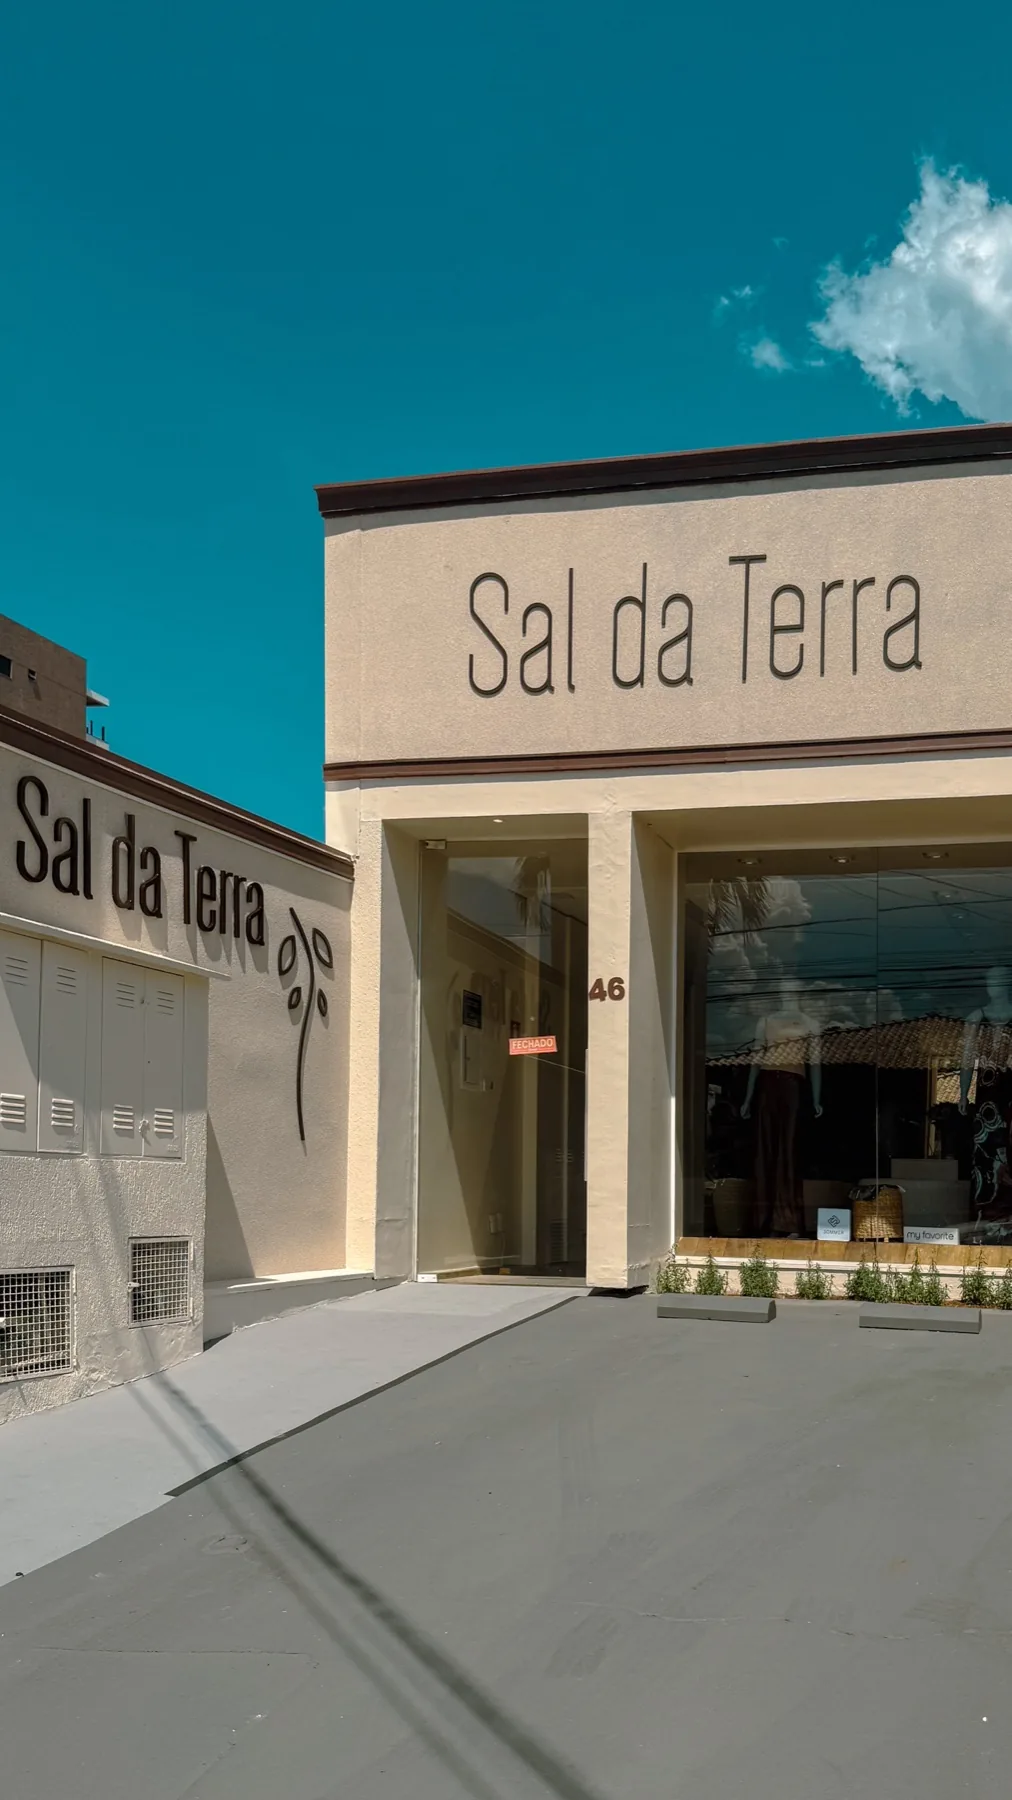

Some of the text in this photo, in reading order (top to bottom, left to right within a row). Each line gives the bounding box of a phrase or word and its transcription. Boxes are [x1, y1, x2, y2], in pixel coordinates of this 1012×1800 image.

[469, 554, 923, 697] Sal da Terra
[16, 775, 265, 946] Sal da Terra
[588, 976, 626, 1002] 46
[512, 1038, 554, 1049] FECHADO
[906, 1230, 954, 1241] my favorite
